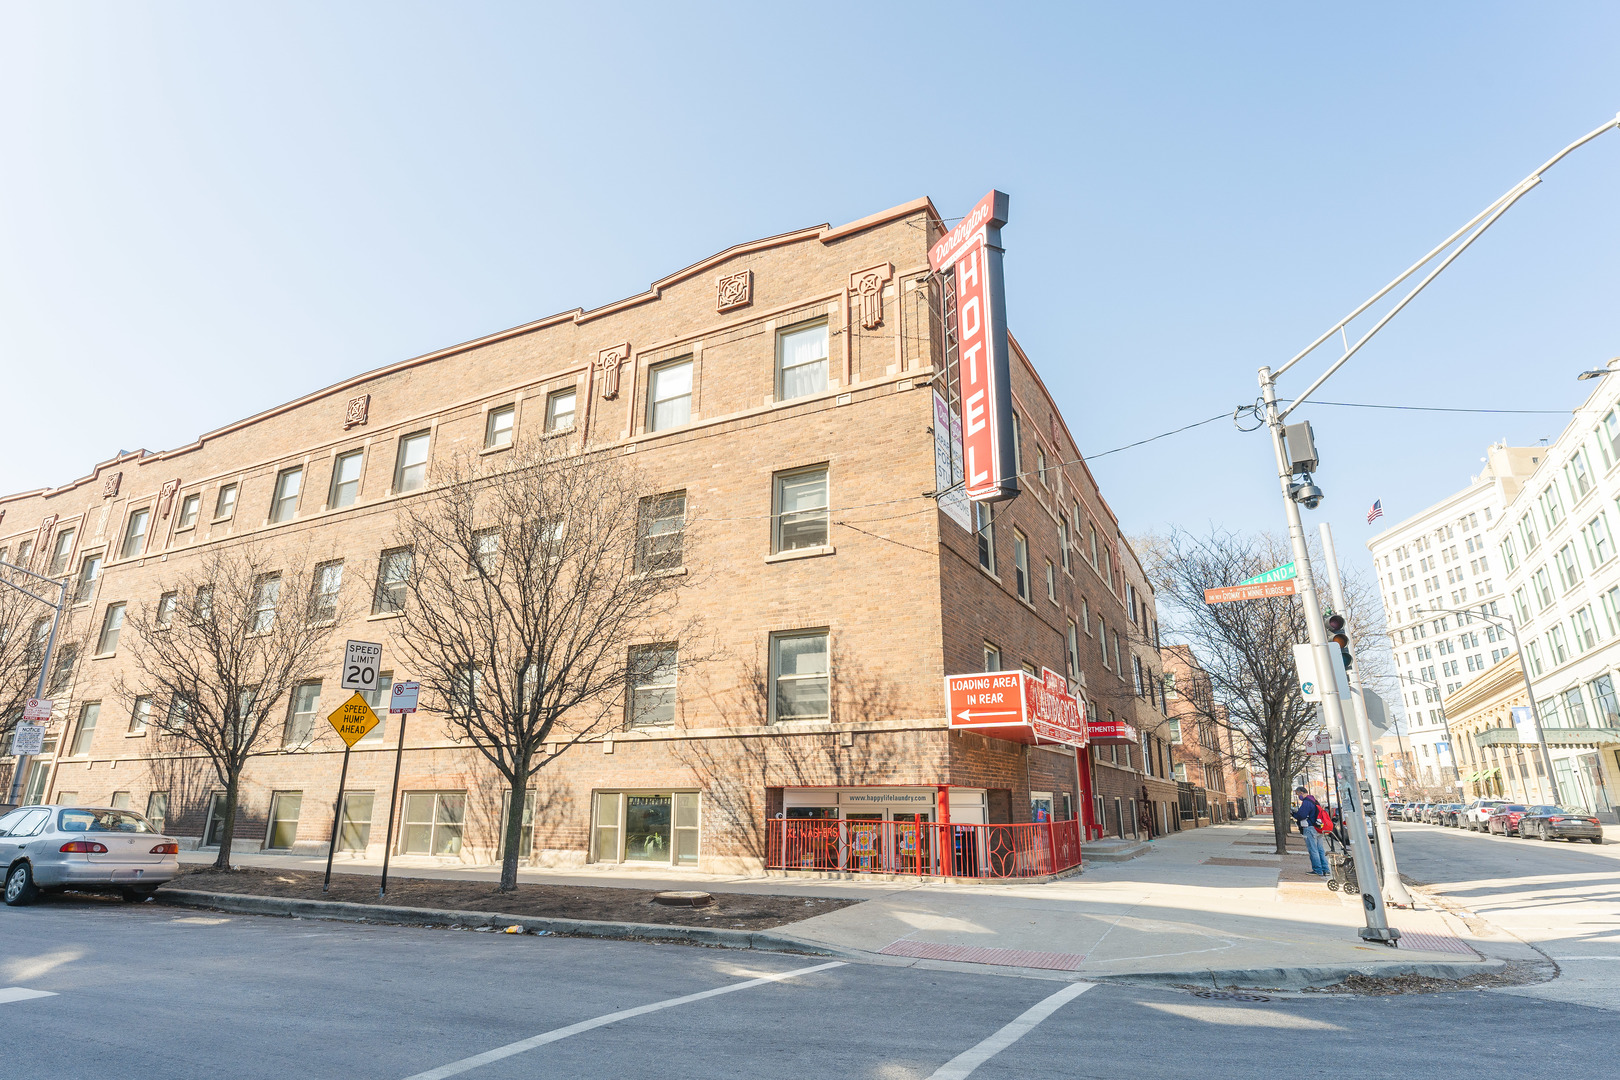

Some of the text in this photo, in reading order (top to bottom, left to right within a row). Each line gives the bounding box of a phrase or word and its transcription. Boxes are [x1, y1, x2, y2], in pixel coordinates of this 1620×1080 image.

[936, 204, 989, 263] Darlington
[959, 250, 988, 488] HOTEL
[349, 644, 379, 655] SPEED
[351, 655, 375, 664] LIMIT
[346, 665, 375, 684] 20
[952, 676, 1018, 691] LOADING AREA
[967, 693, 1004, 705] IN REAR
[344, 704, 367, 714] SPEED
[343, 714, 365, 724] HUMP
[340, 724, 365, 734] AHEAD
[849, 794, 927, 803] www.happylifelaundry.com
